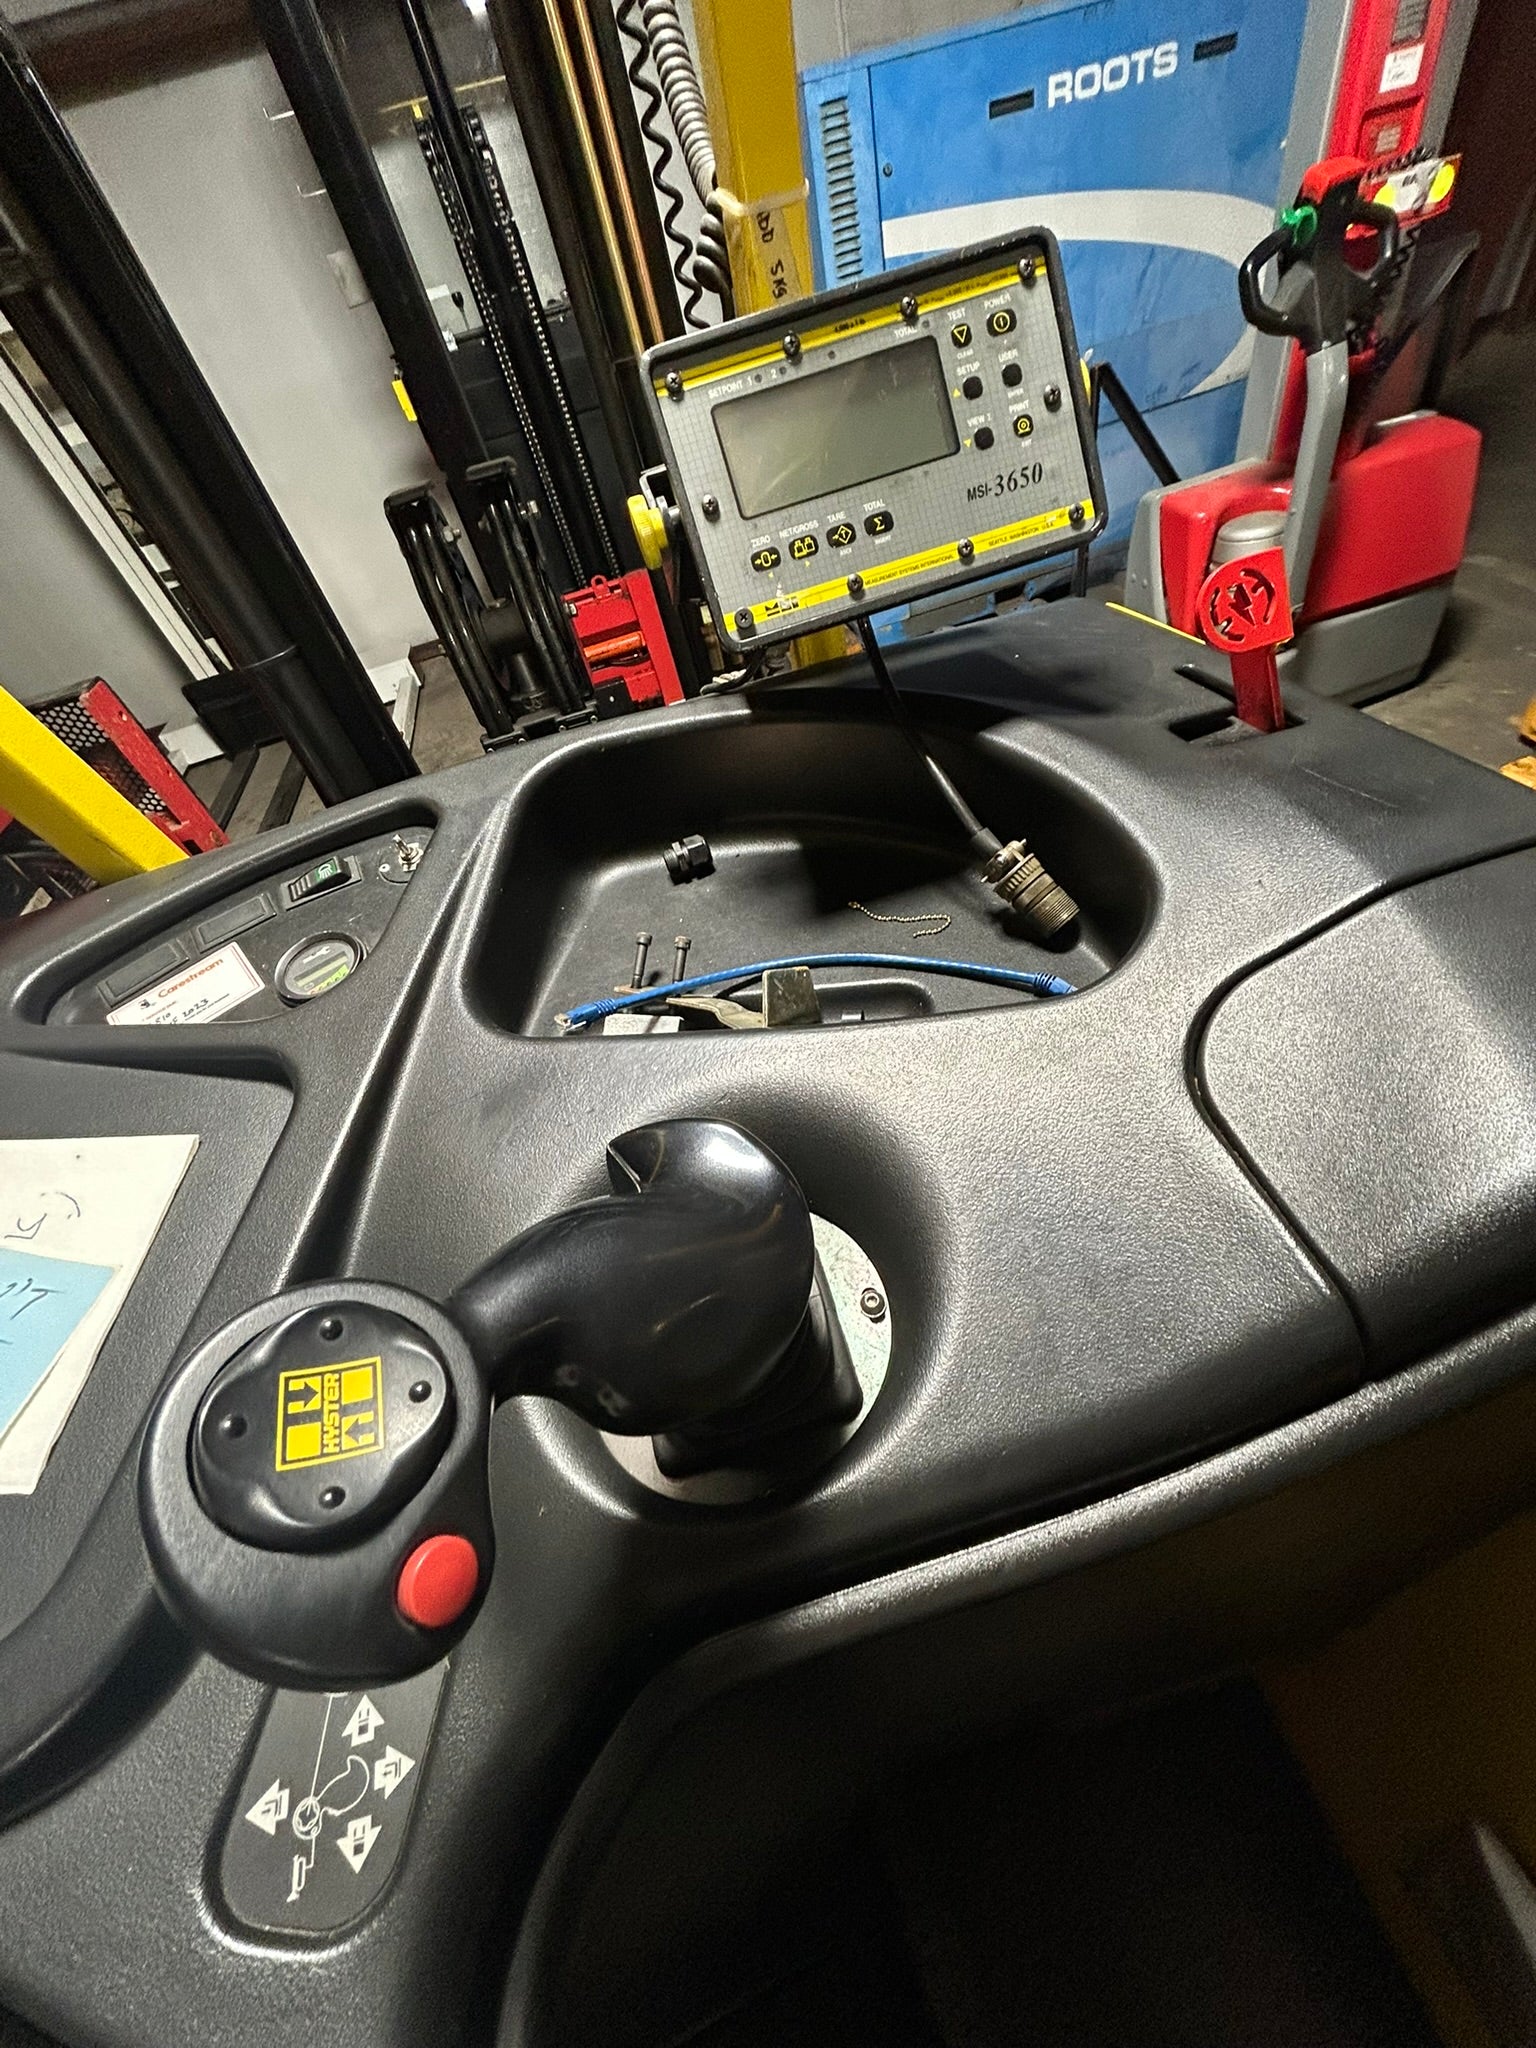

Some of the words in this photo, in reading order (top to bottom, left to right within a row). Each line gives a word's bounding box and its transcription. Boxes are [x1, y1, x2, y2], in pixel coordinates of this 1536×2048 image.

[1048, 42, 1178, 108] ROOTS
[983, 292, 1011, 309] POWER
[946, 307, 966, 321] TEST
[894, 325, 918, 339] TOTAL
[998, 348, 1019, 363] USER
[956, 360, 981, 377] SETUP
[707, 379, 743, 399] SETPOINT
[747, 376, 753, 386] 1
[770, 368, 777, 379] 2
[1008, 399, 1030, 414] PRINT
[966, 414, 985, 428] VIEW
[967, 462, 1043, 503] MSI-3650
[863, 498, 886, 512] TOTAL
[826, 511, 847, 524] TARE
[779, 519, 820, 539] NET/GROSS
[750, 534, 771, 549] ZERO
[864, 570, 898, 586] MEASUREMENT
[898, 562, 920, 576] SYSTEMS
[920, 553, 954, 569] INTERNATIONAL
[158, 958, 224, 998] Carestream
[322, 1372, 340, 1454] HYSTER
